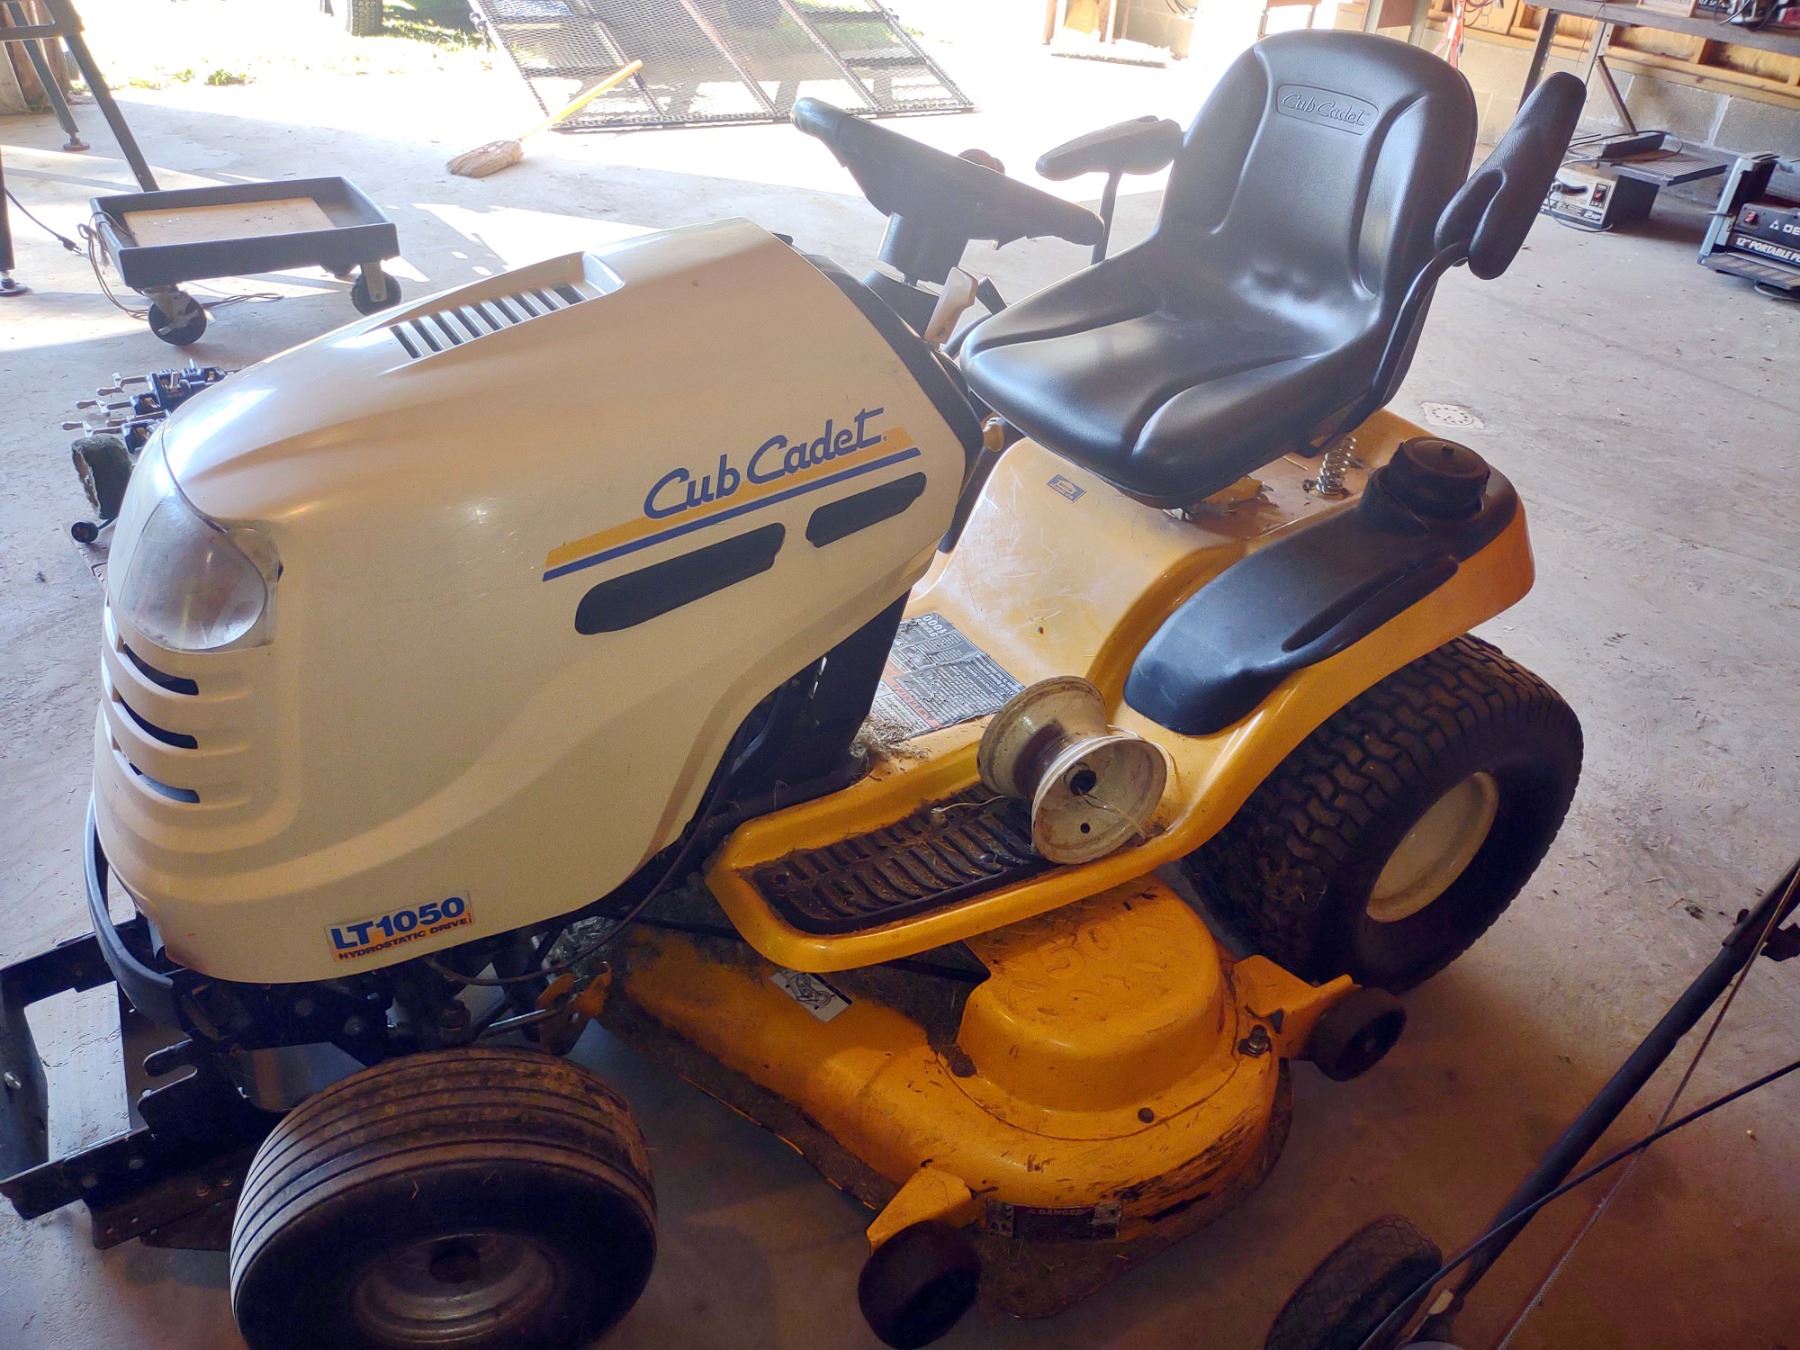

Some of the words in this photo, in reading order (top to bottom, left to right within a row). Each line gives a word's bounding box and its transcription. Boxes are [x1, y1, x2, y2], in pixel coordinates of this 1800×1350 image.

[1282, 93, 1316, 112] Cub
[1317, 101, 1366, 126] Cadet
[1749, 240, 1791, 259] PORTABLE
[644, 453, 741, 519] Cub
[747, 407, 884, 484] Cadet
[922, 615, 947, 633] 1000
[331, 896, 465, 949] LT1050
[338, 930, 426, 960] HYDROSTATIC
[430, 917, 468, 935] DRIVE
